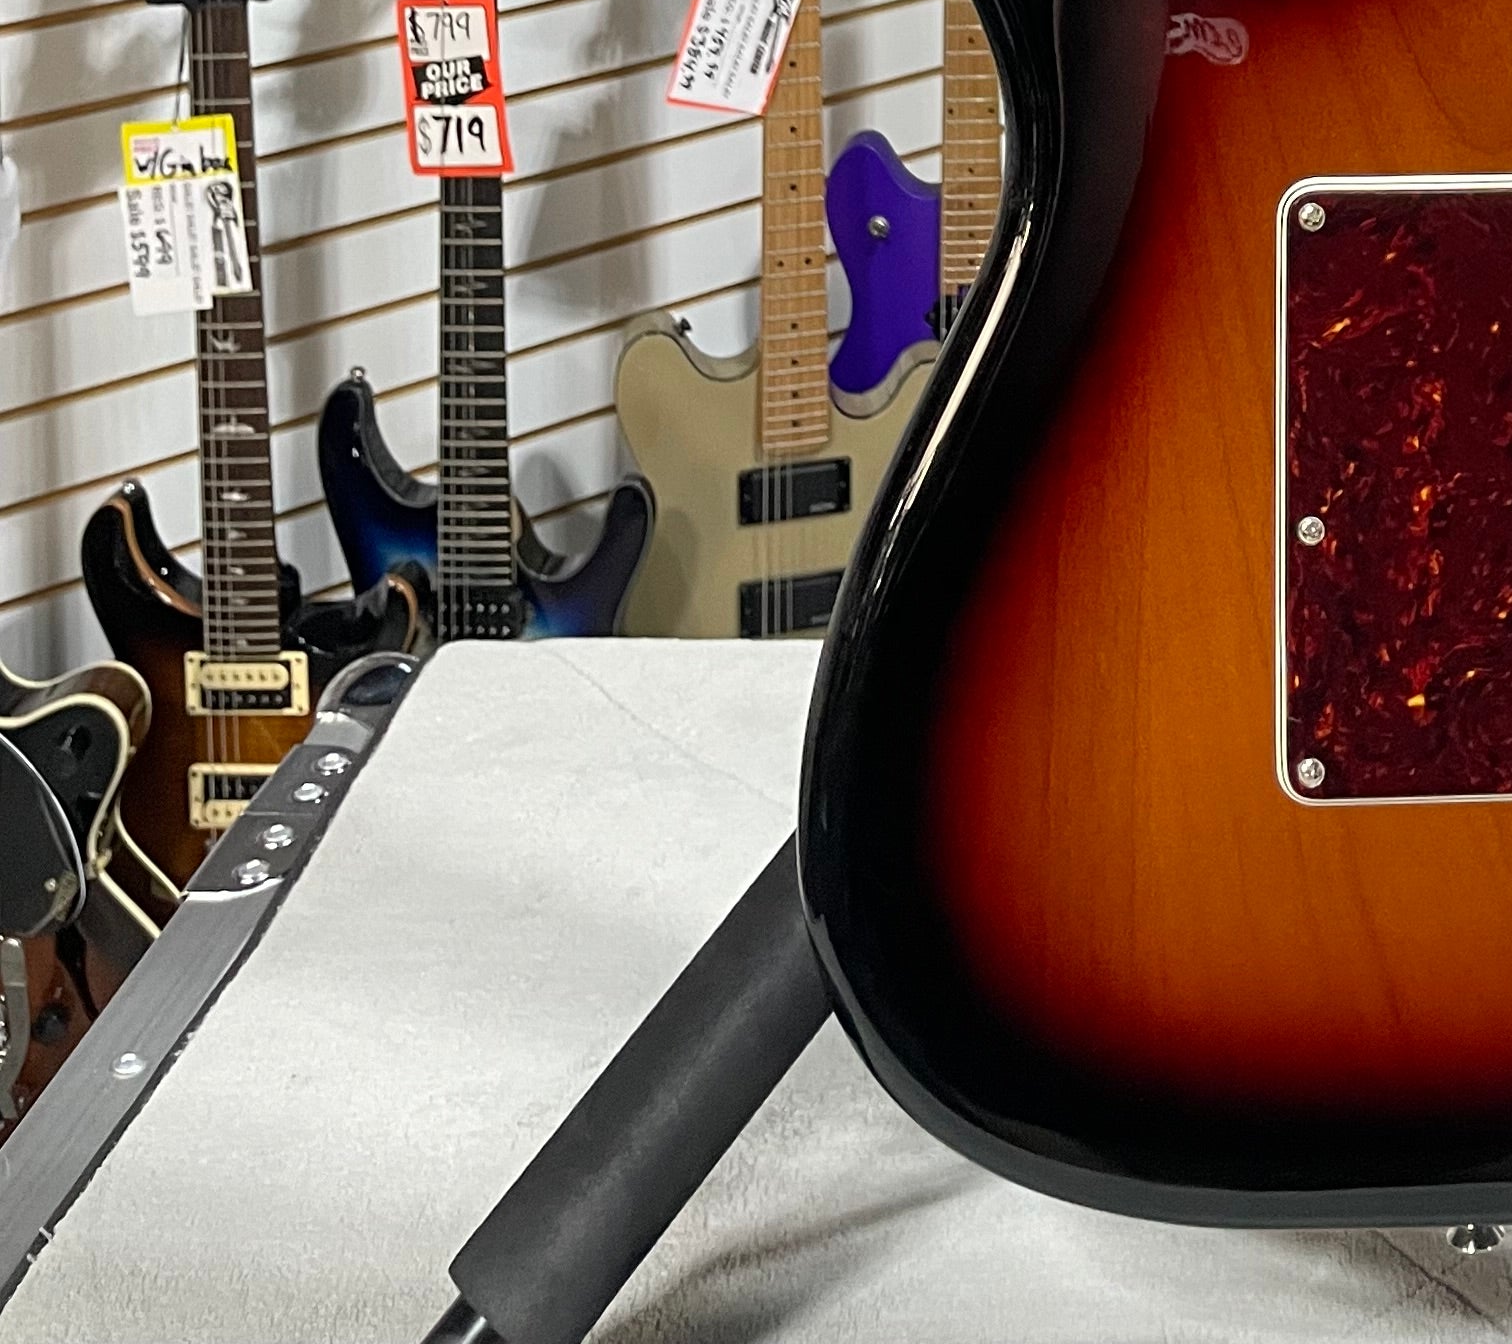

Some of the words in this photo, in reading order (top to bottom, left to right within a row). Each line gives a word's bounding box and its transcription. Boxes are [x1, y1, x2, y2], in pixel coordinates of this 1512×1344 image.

[426, 59, 472, 81] OUR
[421, 72, 485, 101] PRICE
[417, 115, 486, 156] $719
